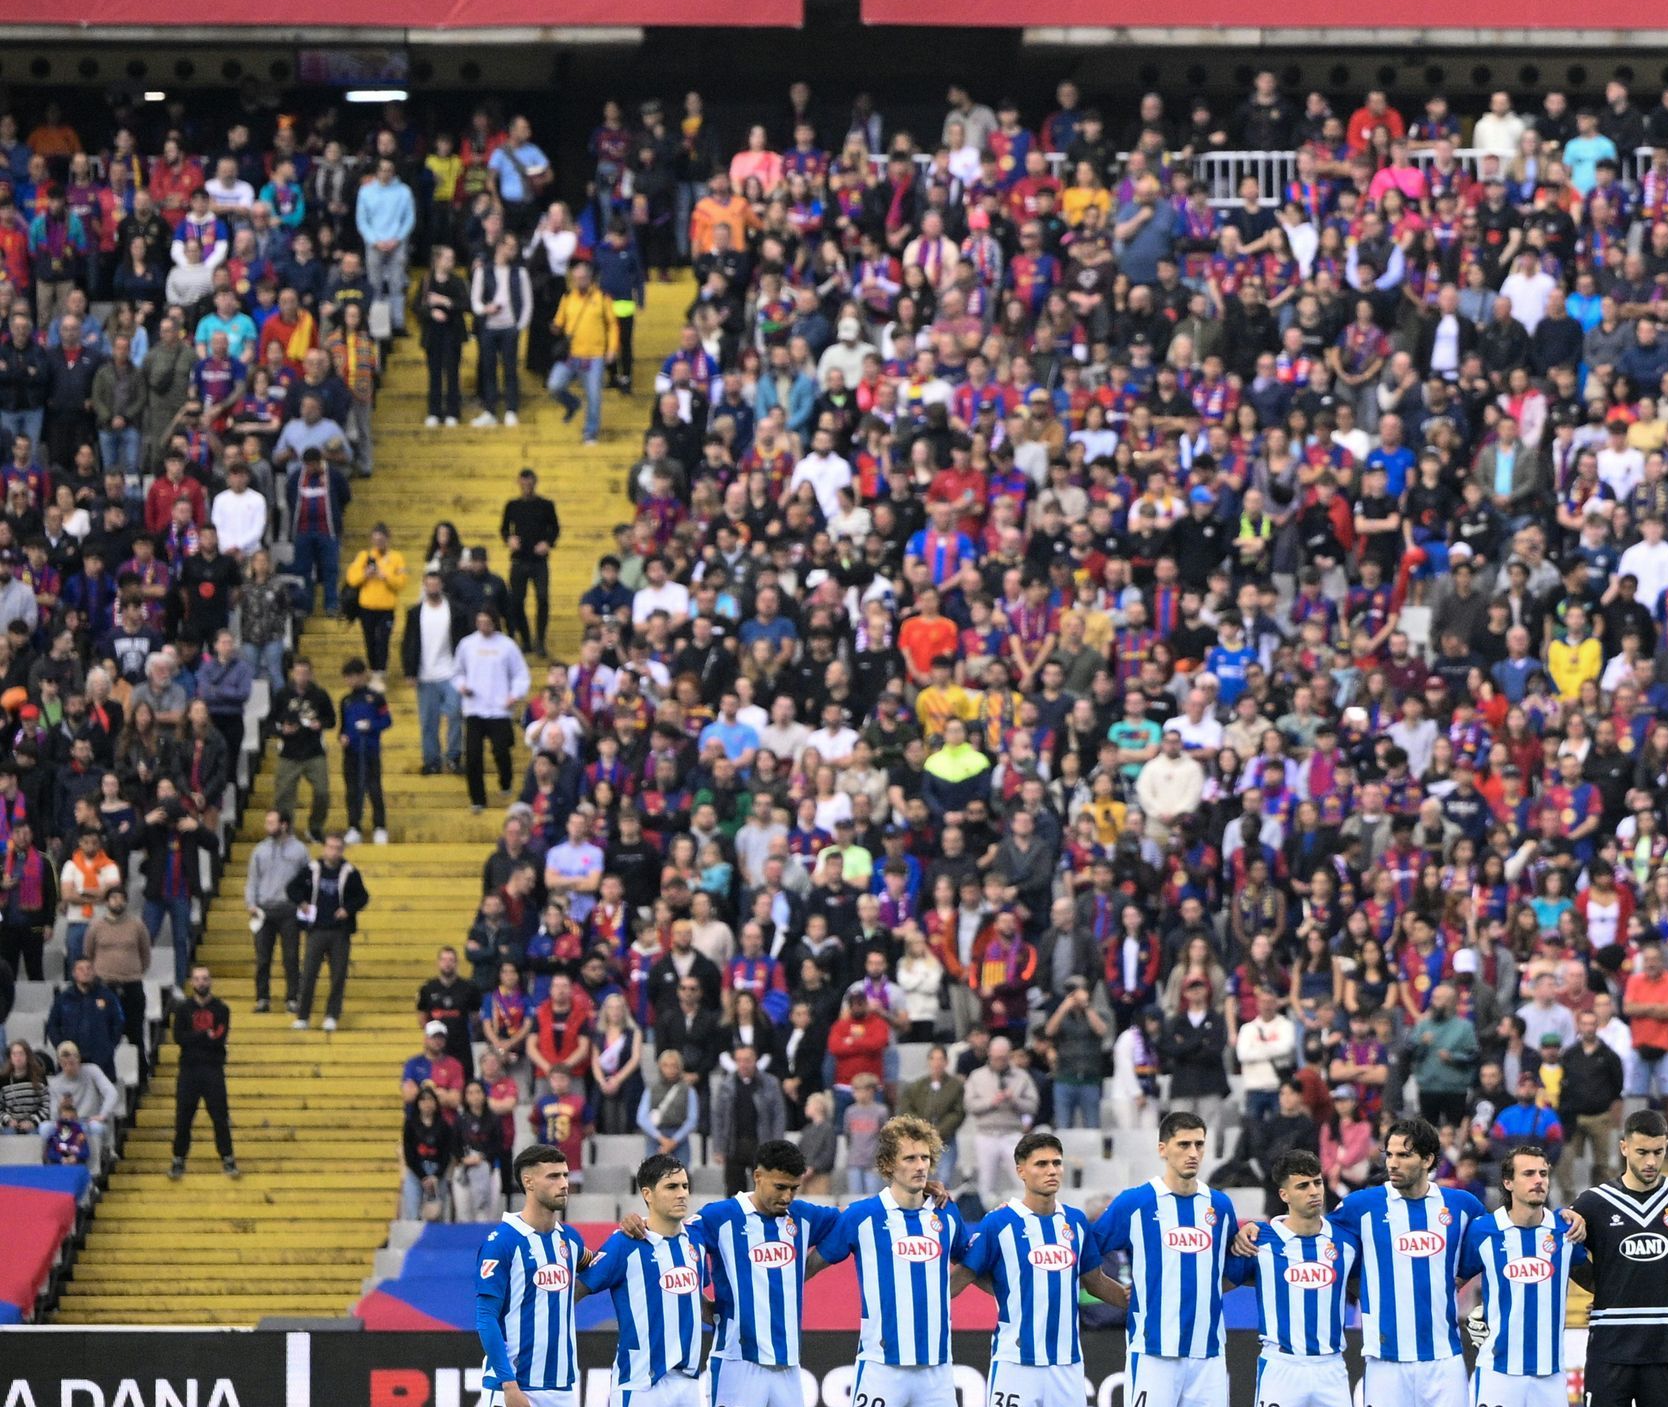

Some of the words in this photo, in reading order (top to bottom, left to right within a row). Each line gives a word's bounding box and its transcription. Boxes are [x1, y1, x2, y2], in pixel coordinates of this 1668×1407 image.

[1168, 1233, 1203, 1248] DANI
[1399, 1237, 1436, 1251] DANI
[1624, 1239, 1662, 1256] DANI
[753, 1246, 789, 1263] DANI
[897, 1241, 933, 1256] DANI
[1034, 1250, 1068, 1265] DANI
[538, 1268, 567, 1286] DANI
[1289, 1268, 1327, 1283] DANI
[1509, 1263, 1545, 1279] DANI
[664, 1271, 696, 1290] DANI
